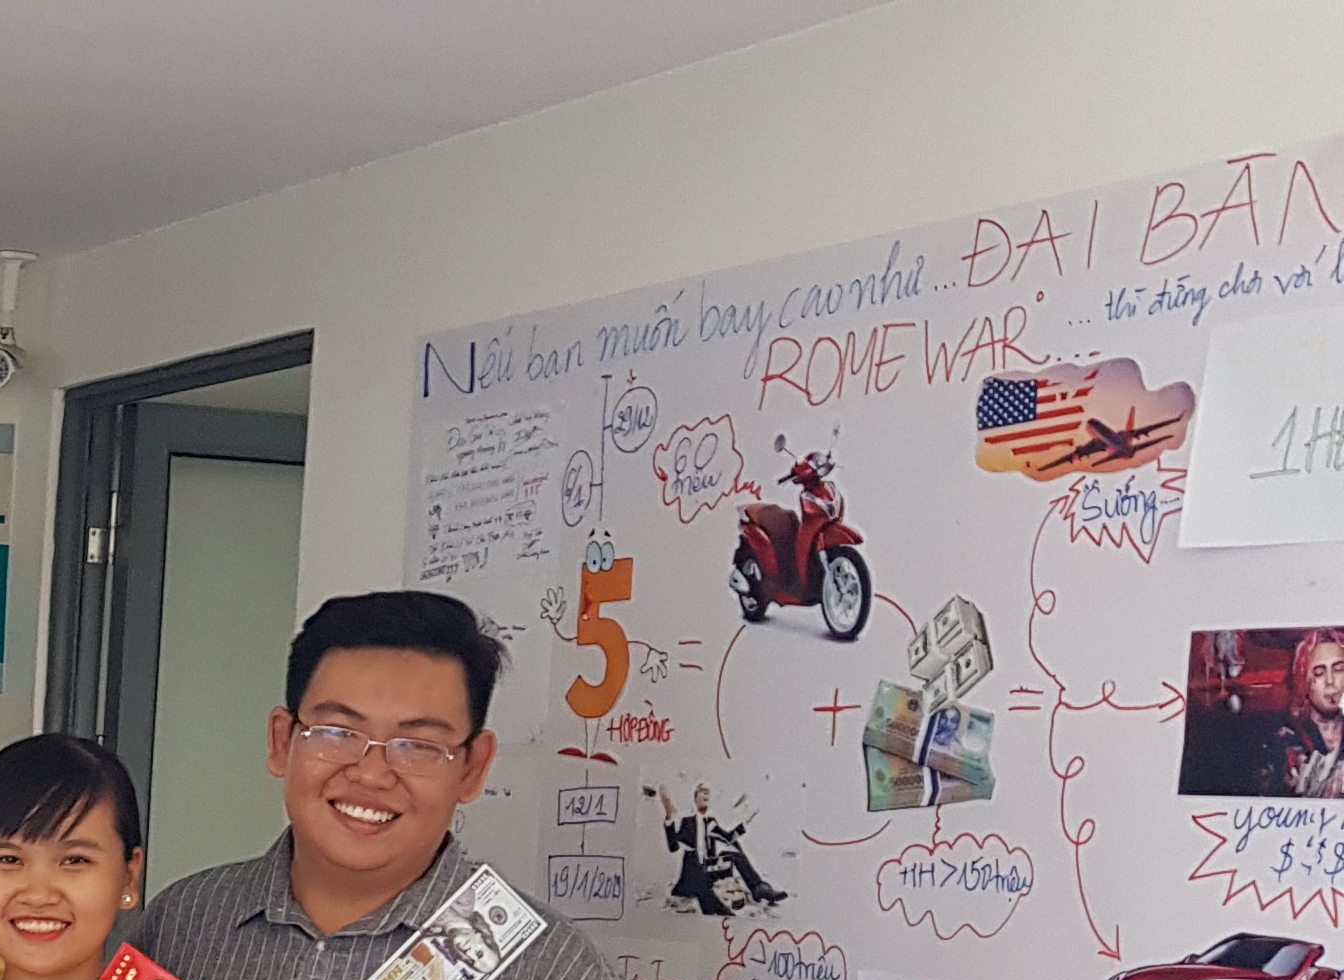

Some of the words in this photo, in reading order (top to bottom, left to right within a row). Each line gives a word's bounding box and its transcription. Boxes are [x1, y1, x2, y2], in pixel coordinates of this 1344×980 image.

[698, 279, 773, 380] bay
[778, 282, 844, 330] cao
[757, 322, 916, 411] ROME
[673, 431, 720, 475] 60
